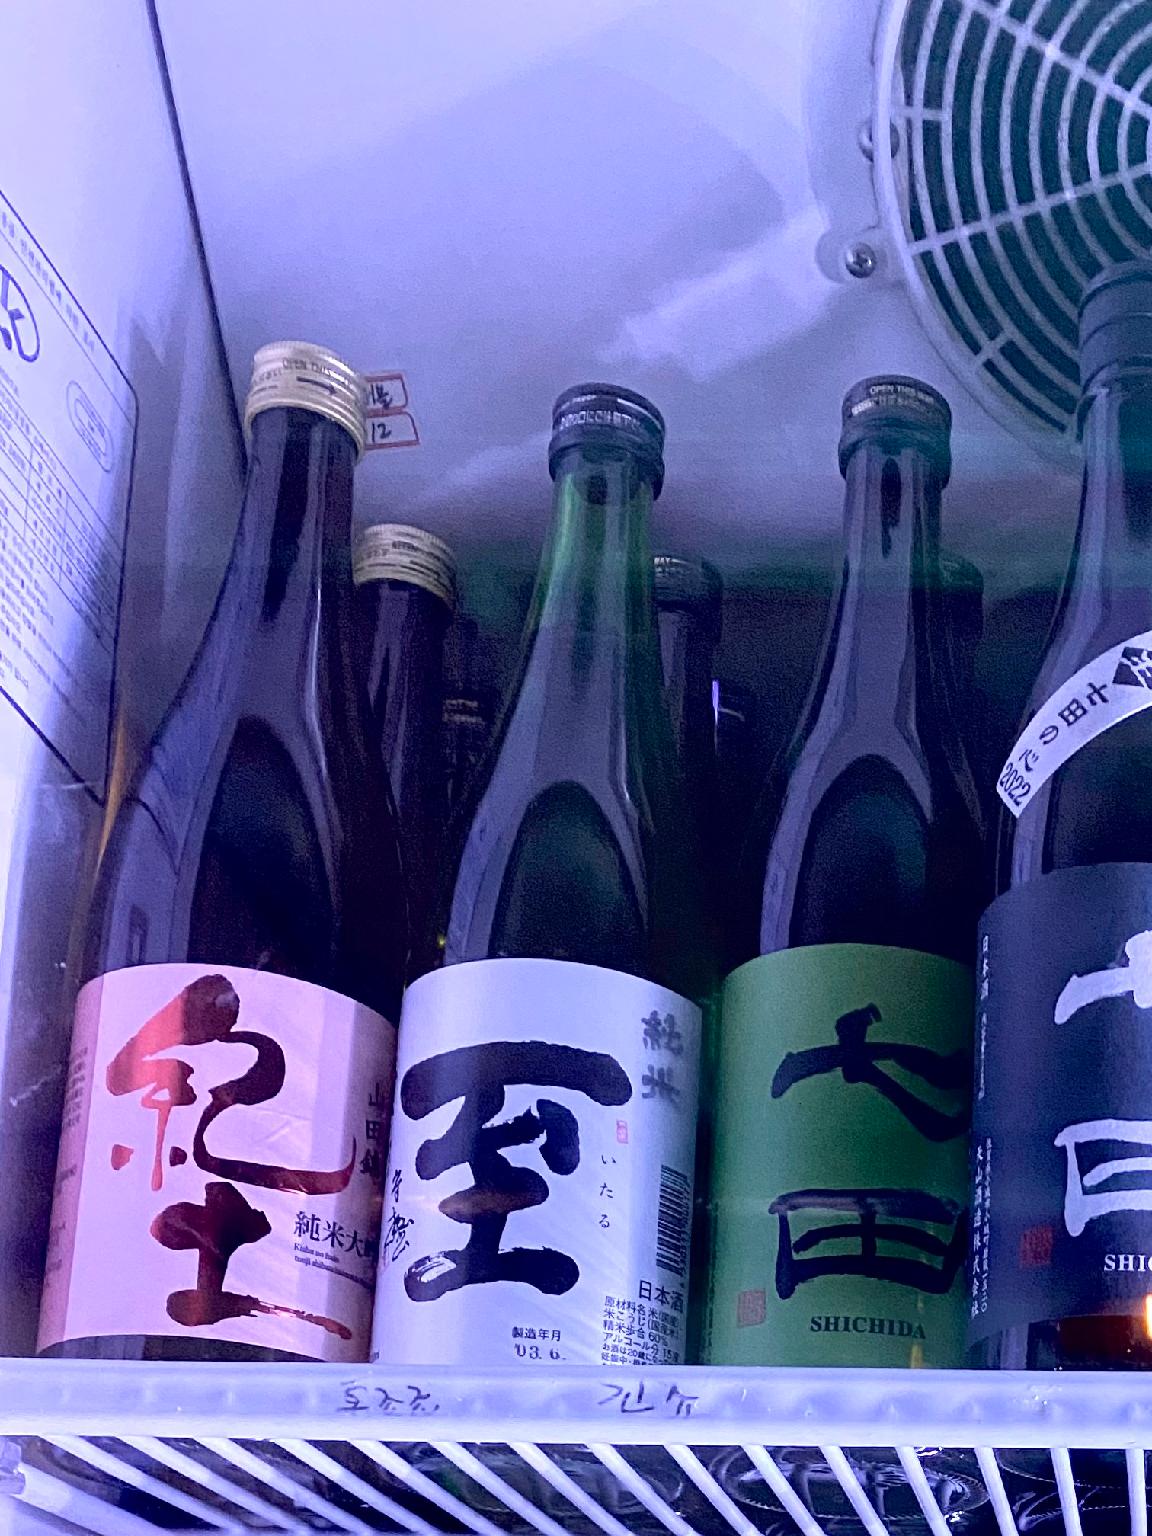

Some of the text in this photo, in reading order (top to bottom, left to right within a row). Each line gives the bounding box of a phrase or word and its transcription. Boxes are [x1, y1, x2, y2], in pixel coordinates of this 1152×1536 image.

[1000, 762, 1032, 806] 2022
[400, 1040, 633, 1302] 至
[598, 1151, 618, 1230] いたる
[638, 1279, 685, 1314] 日本酒
[511, 1326, 562, 1343] 製造年月
[809, 1314, 928, 1341] SHICHIDA
